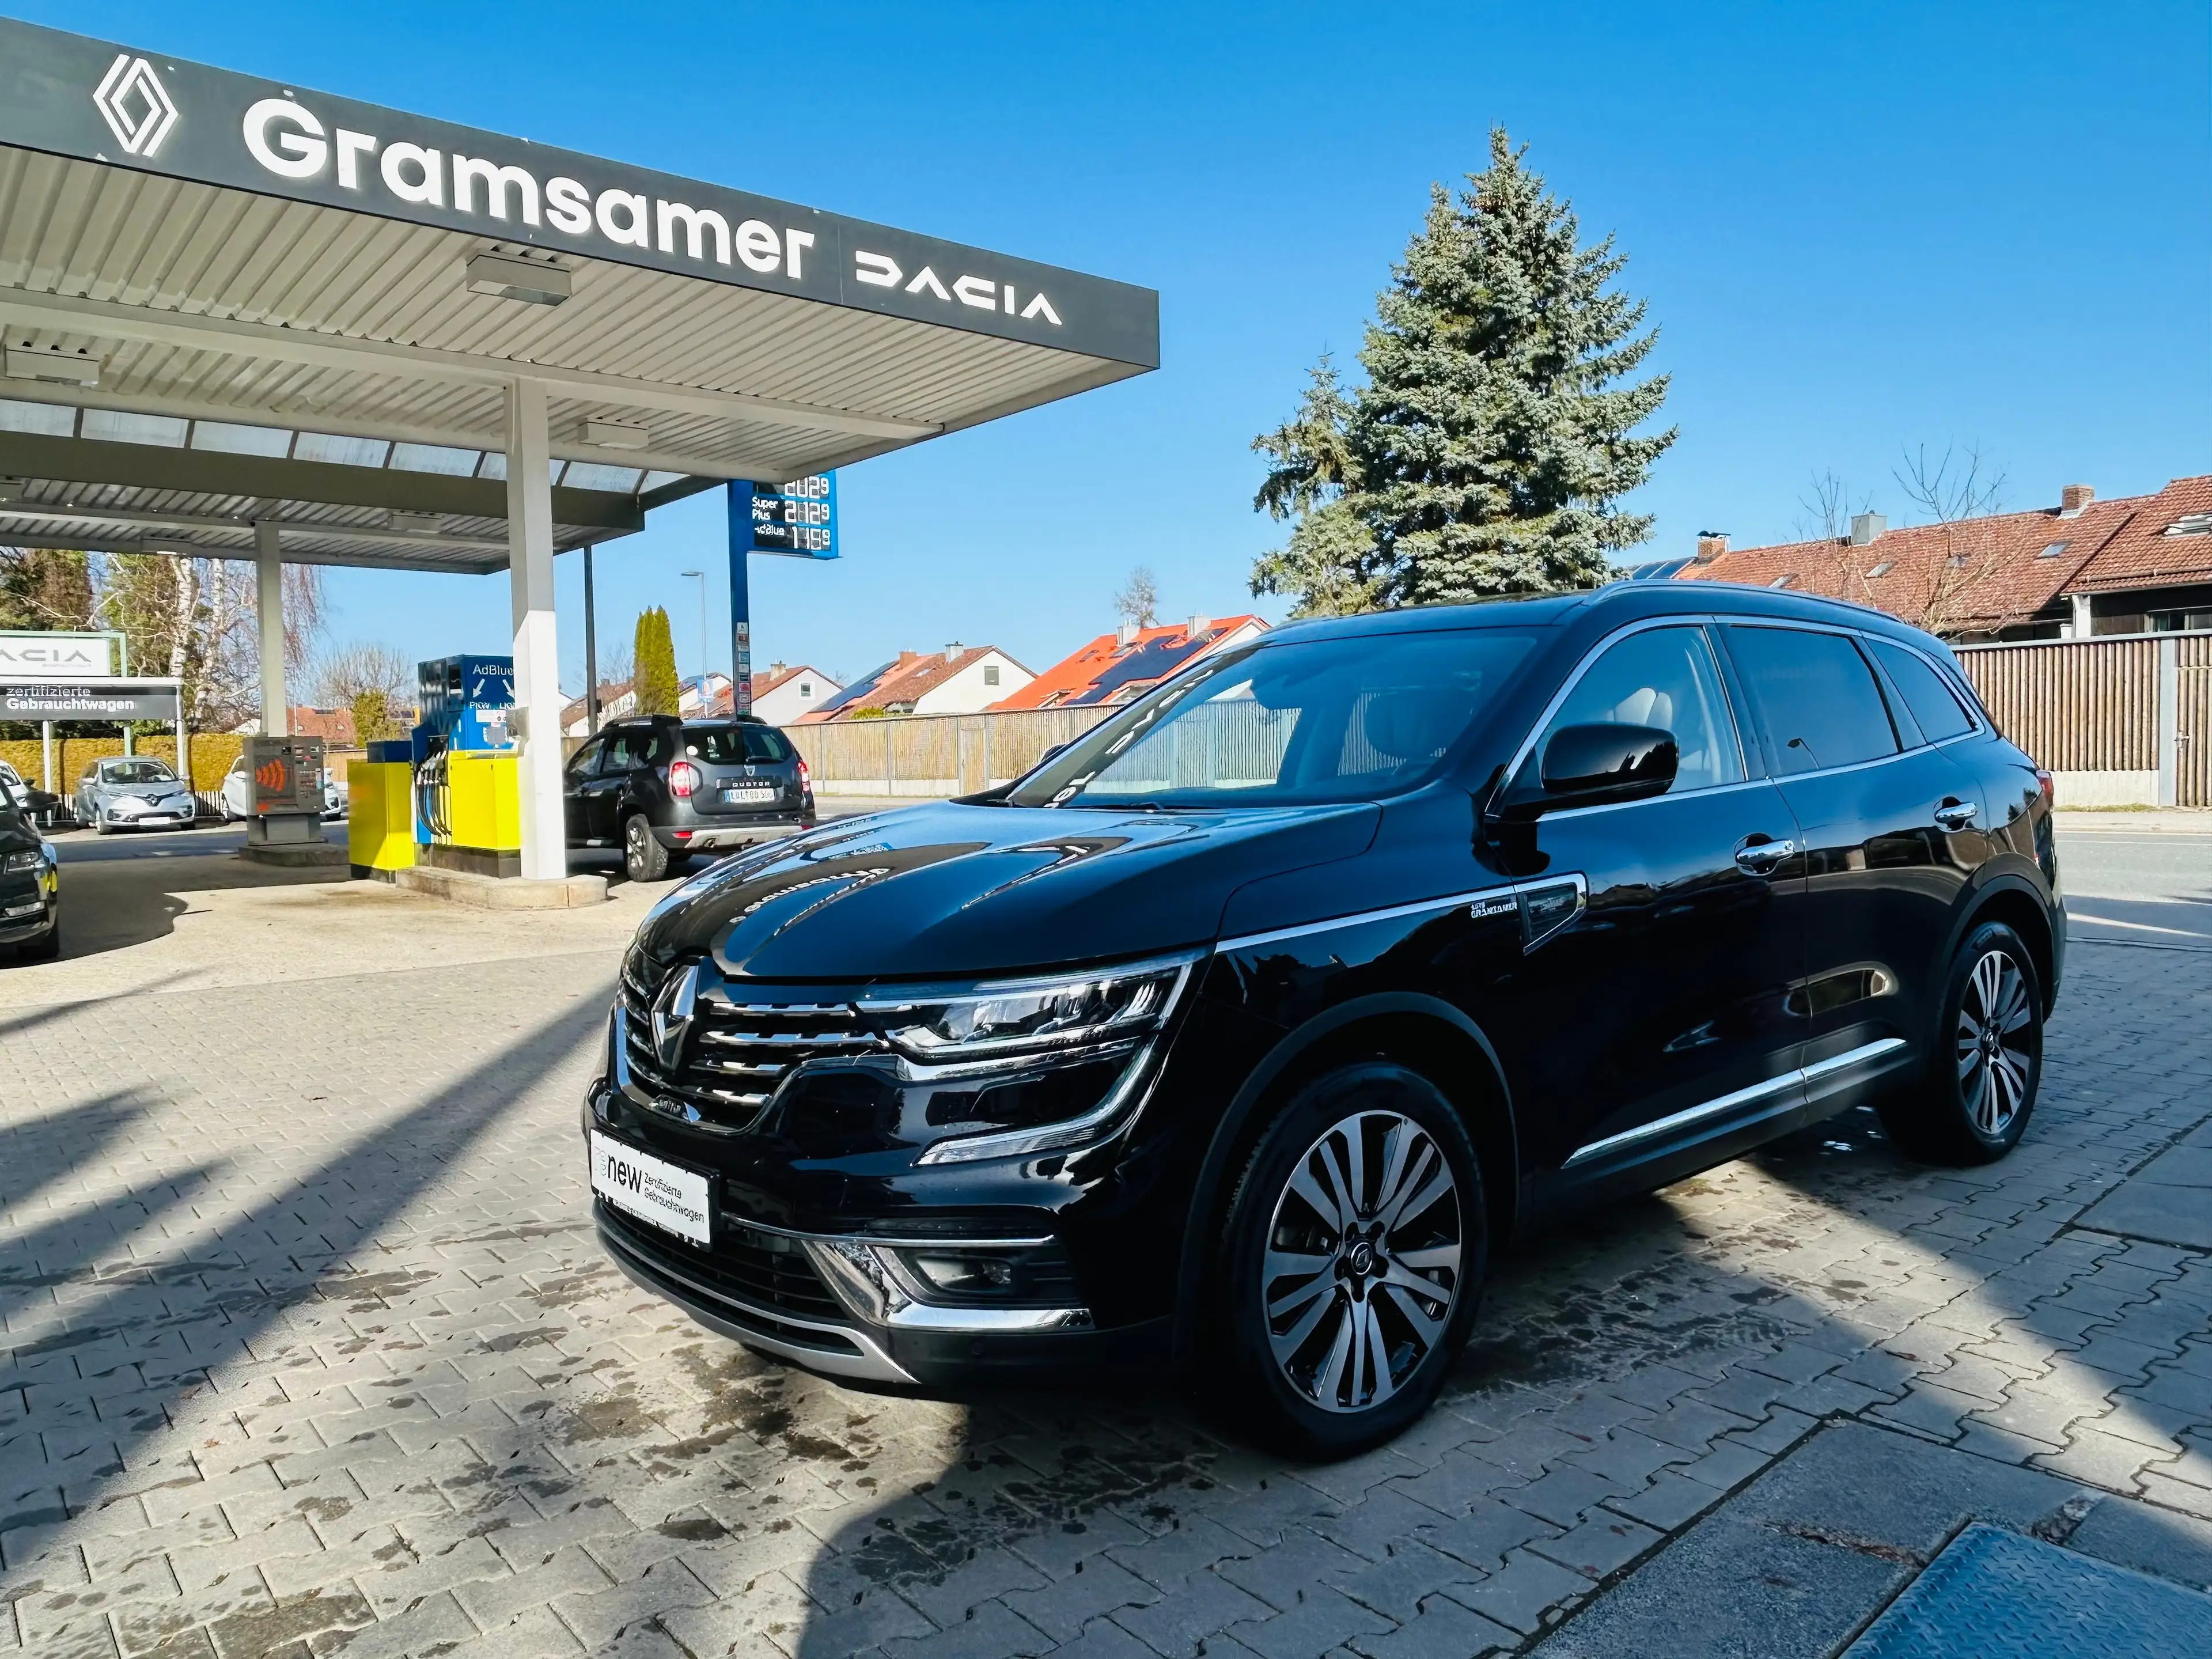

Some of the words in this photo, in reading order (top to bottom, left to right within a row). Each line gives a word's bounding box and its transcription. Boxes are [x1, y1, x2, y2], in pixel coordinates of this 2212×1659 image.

[243, 97, 815, 279] Gramsamer
[855, 250, 1062, 325] DACIA
[752, 497, 779, 509] Super
[752, 509, 771, 521] Plus
[6, 698, 135, 713] Gebrauchtwagen
